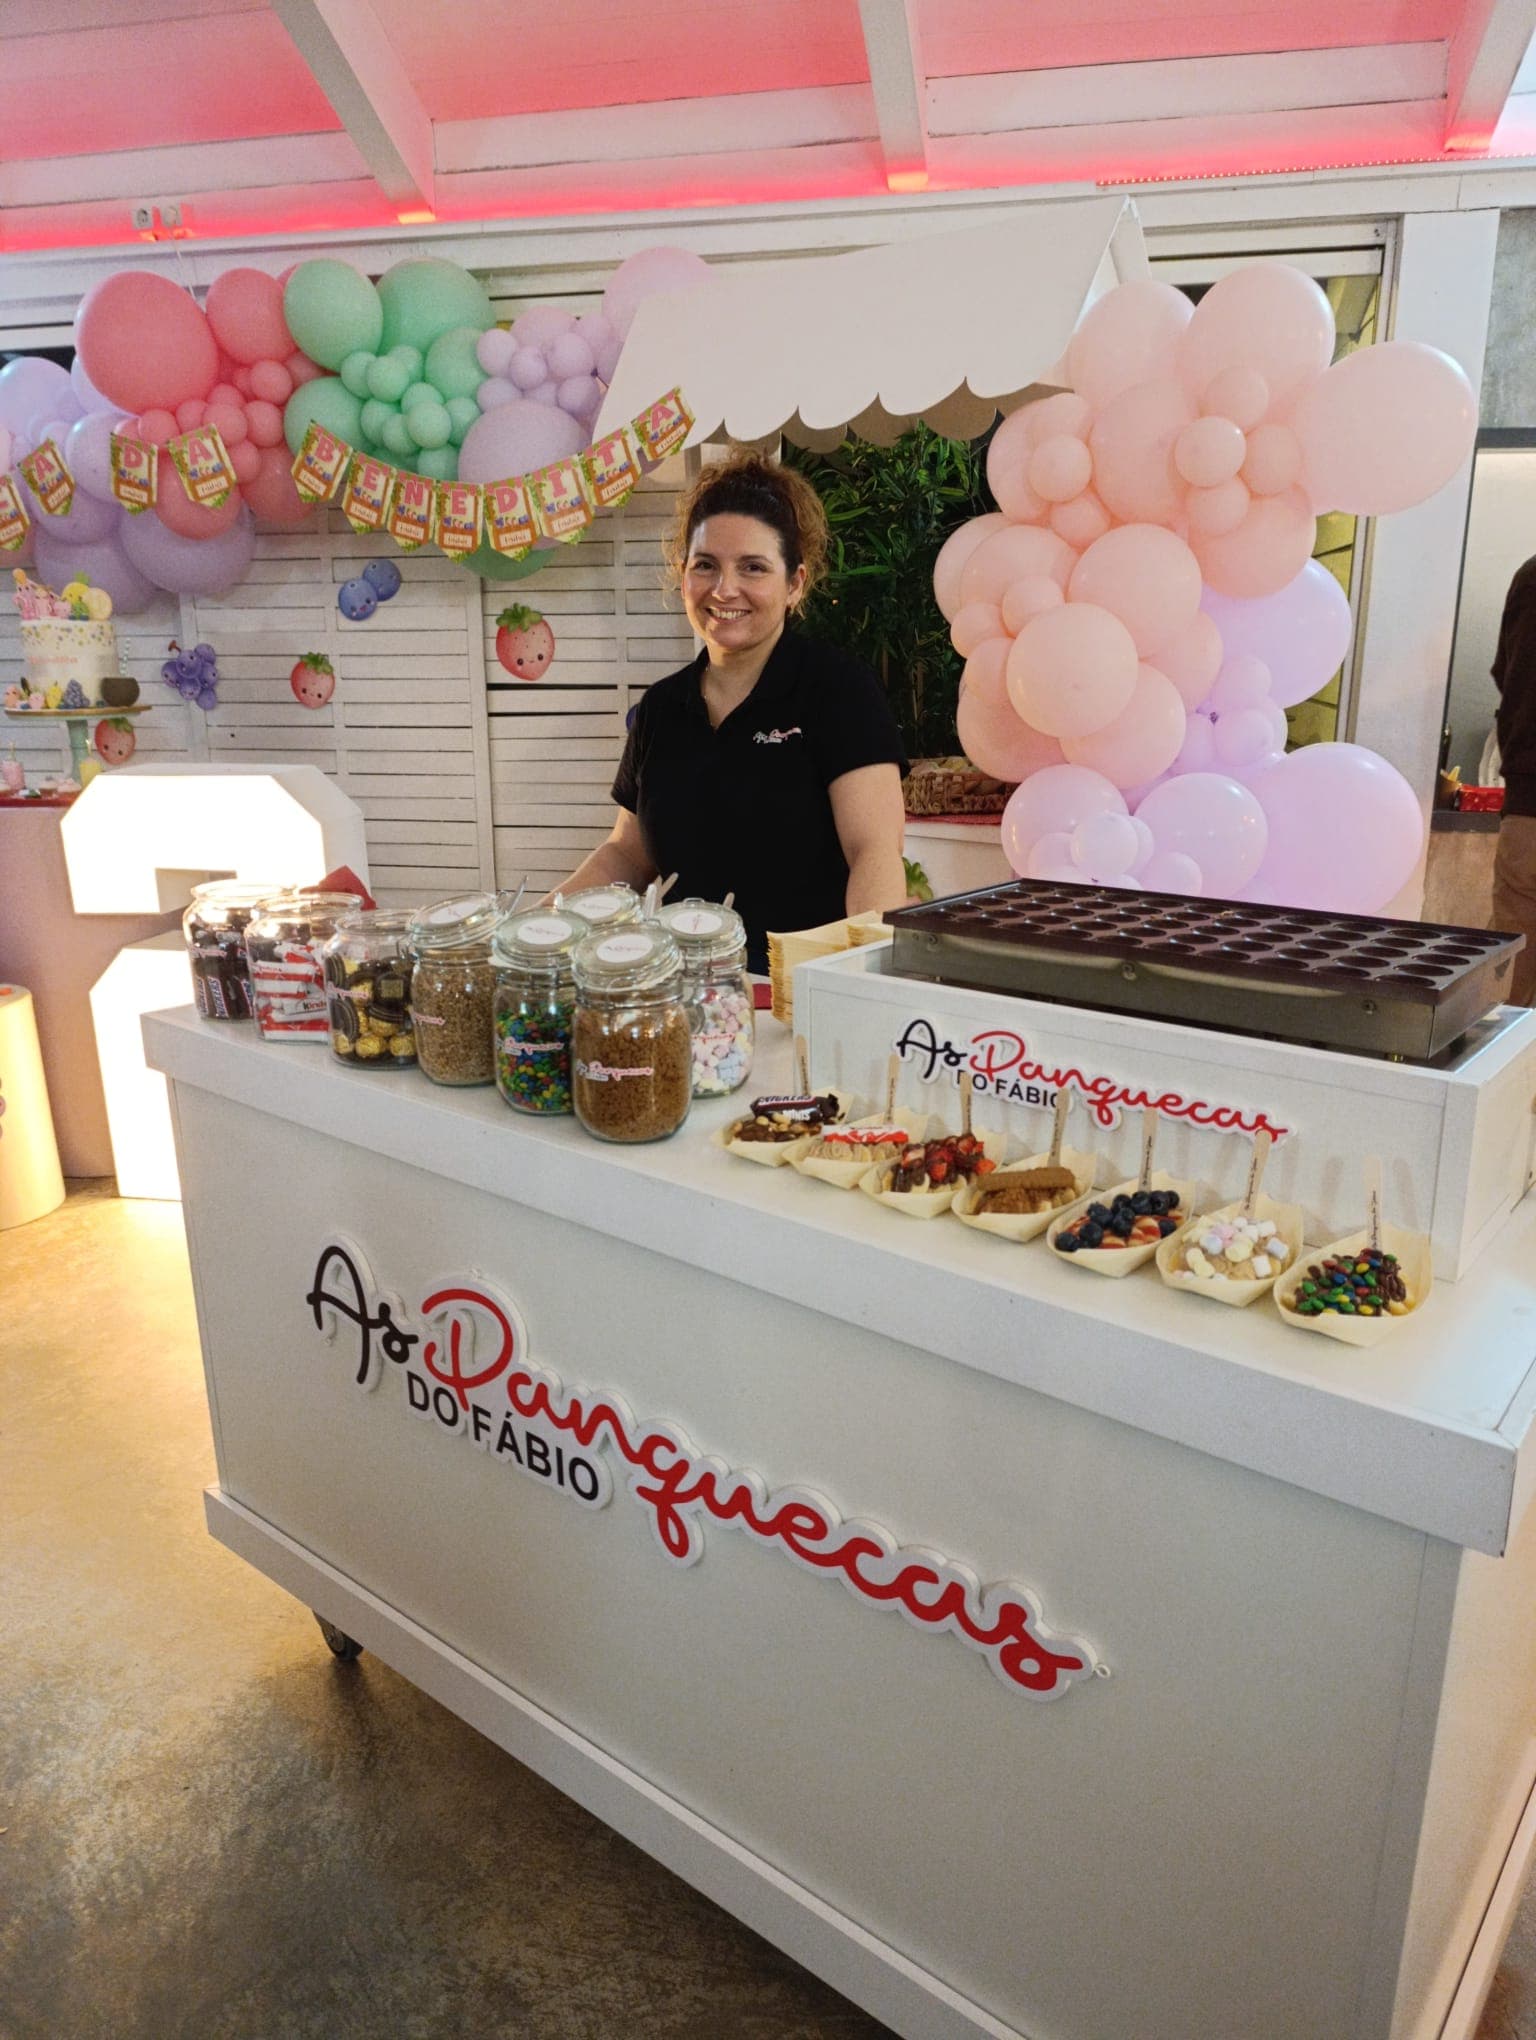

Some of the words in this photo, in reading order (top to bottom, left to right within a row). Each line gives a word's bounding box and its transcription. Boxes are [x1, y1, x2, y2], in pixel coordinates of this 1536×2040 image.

[896, 1019, 967, 1079] As
[970, 1030, 1289, 1142] Panquecas
[306, 1245, 419, 1384] As
[421, 1288, 1084, 1692] Panquecas
[407, 1370, 461, 1428] DO
[472, 1411, 600, 1501] FÁBIO
